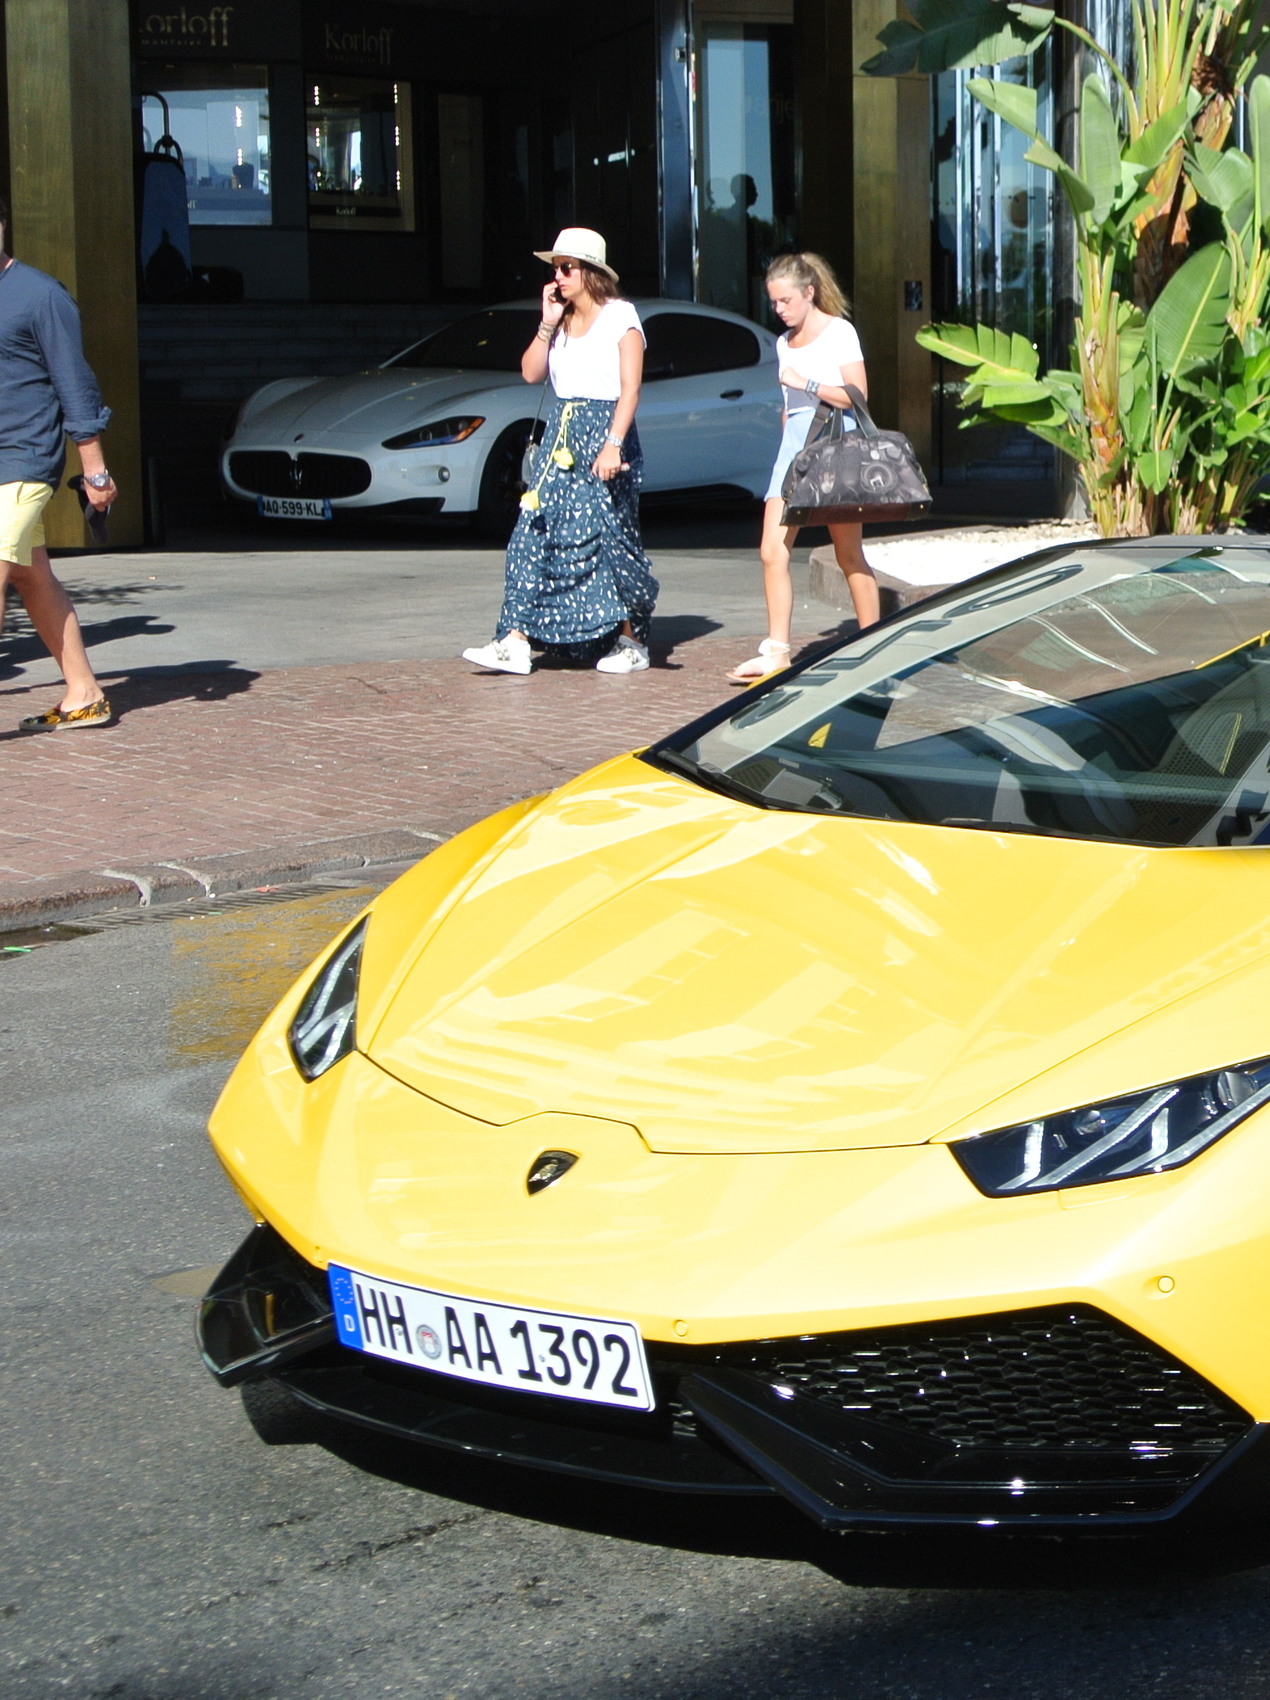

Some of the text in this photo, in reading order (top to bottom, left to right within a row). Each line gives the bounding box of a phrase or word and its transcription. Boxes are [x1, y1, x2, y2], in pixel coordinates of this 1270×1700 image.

[138, 6, 234, 46] orloff
[324, 22, 394, 64] Korloff
[343, 1314, 356, 1332] D
[355, 1283, 639, 1398] HH AA 1392
